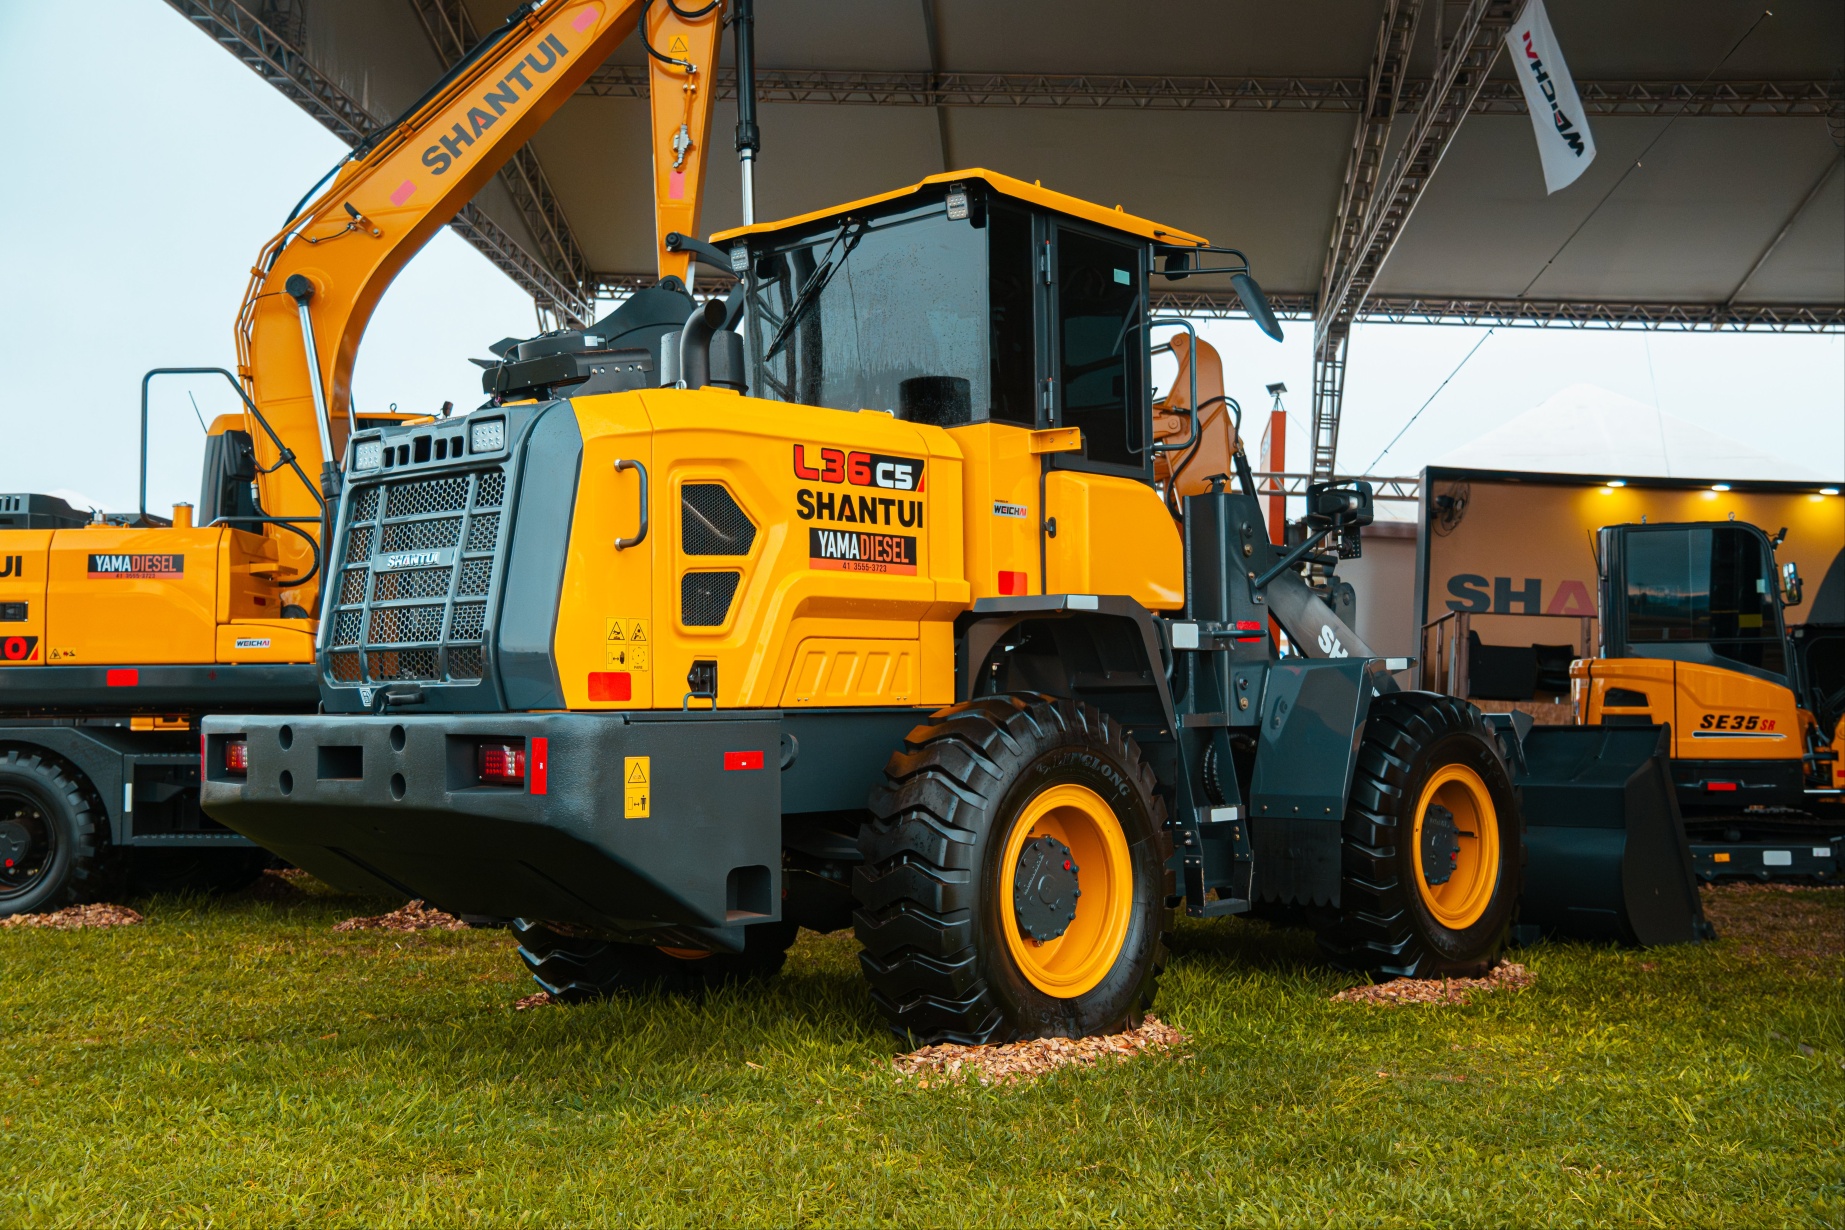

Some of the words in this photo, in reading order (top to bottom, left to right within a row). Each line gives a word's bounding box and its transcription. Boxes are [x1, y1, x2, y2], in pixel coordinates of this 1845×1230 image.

[421, 33, 569, 176] SHANTUI
[1523, 30, 1585, 157] WEICHAI
[793, 443, 872, 486] L36
[875, 462, 913, 490] C5
[796, 488, 924, 528] SHANTUI
[387, 552, 440, 569] SHANTUI
[842, 561, 851, 571] 41
[853, 562, 887, 573] 3555-3723
[1445, 573, 1597, 616] SHA
